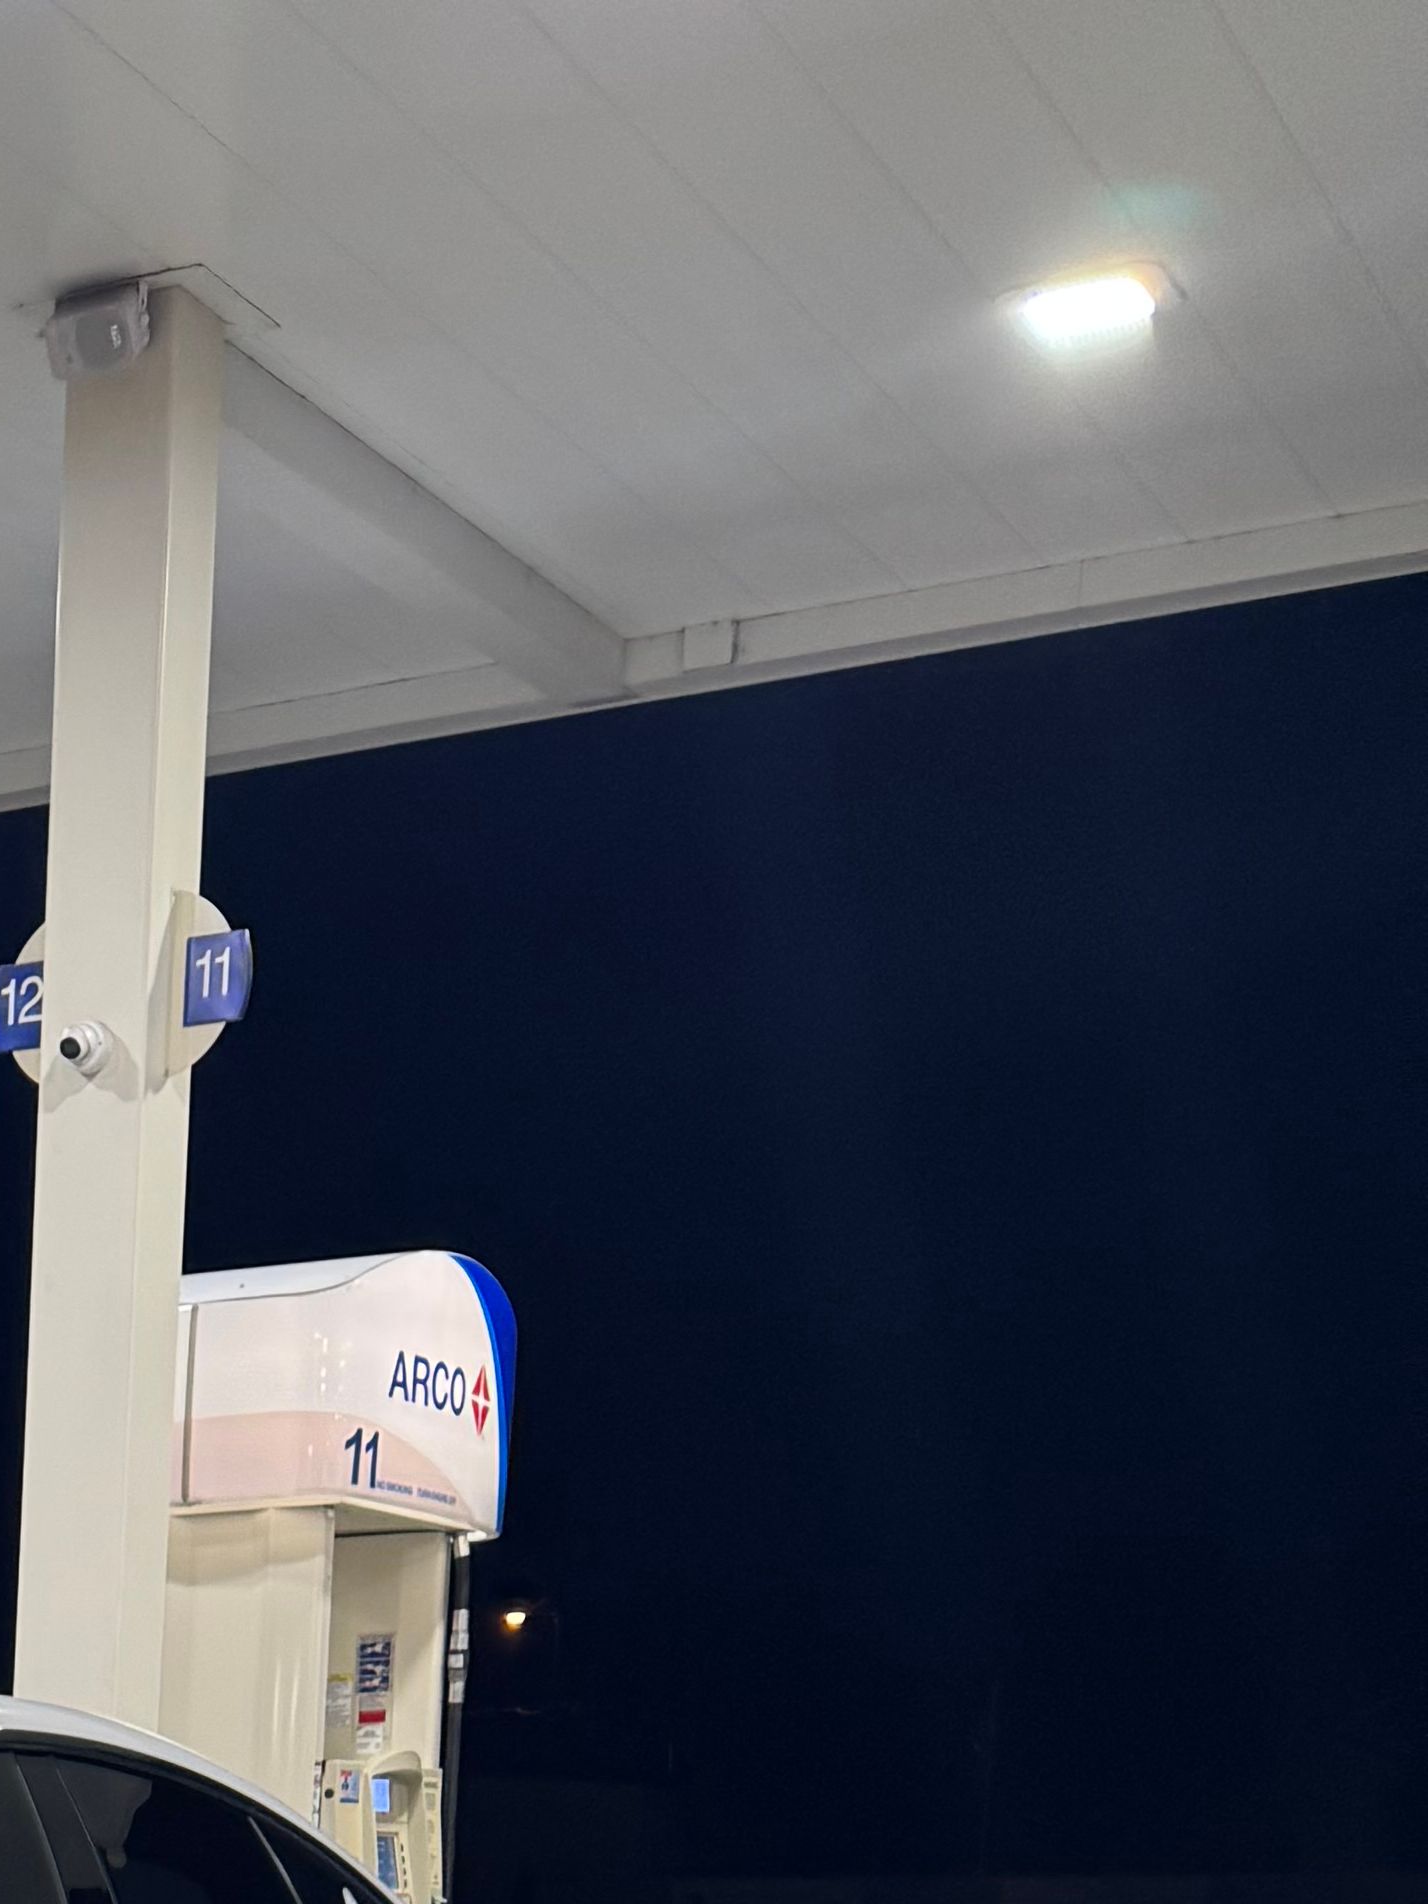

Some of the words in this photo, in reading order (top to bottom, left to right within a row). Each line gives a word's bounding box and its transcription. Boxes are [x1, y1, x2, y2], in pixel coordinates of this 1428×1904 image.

[1, 975, 44, 1026] 12
[196, 946, 231, 999] 11
[388, 1350, 466, 1416] ARCO
[344, 1427, 380, 1489] 11
